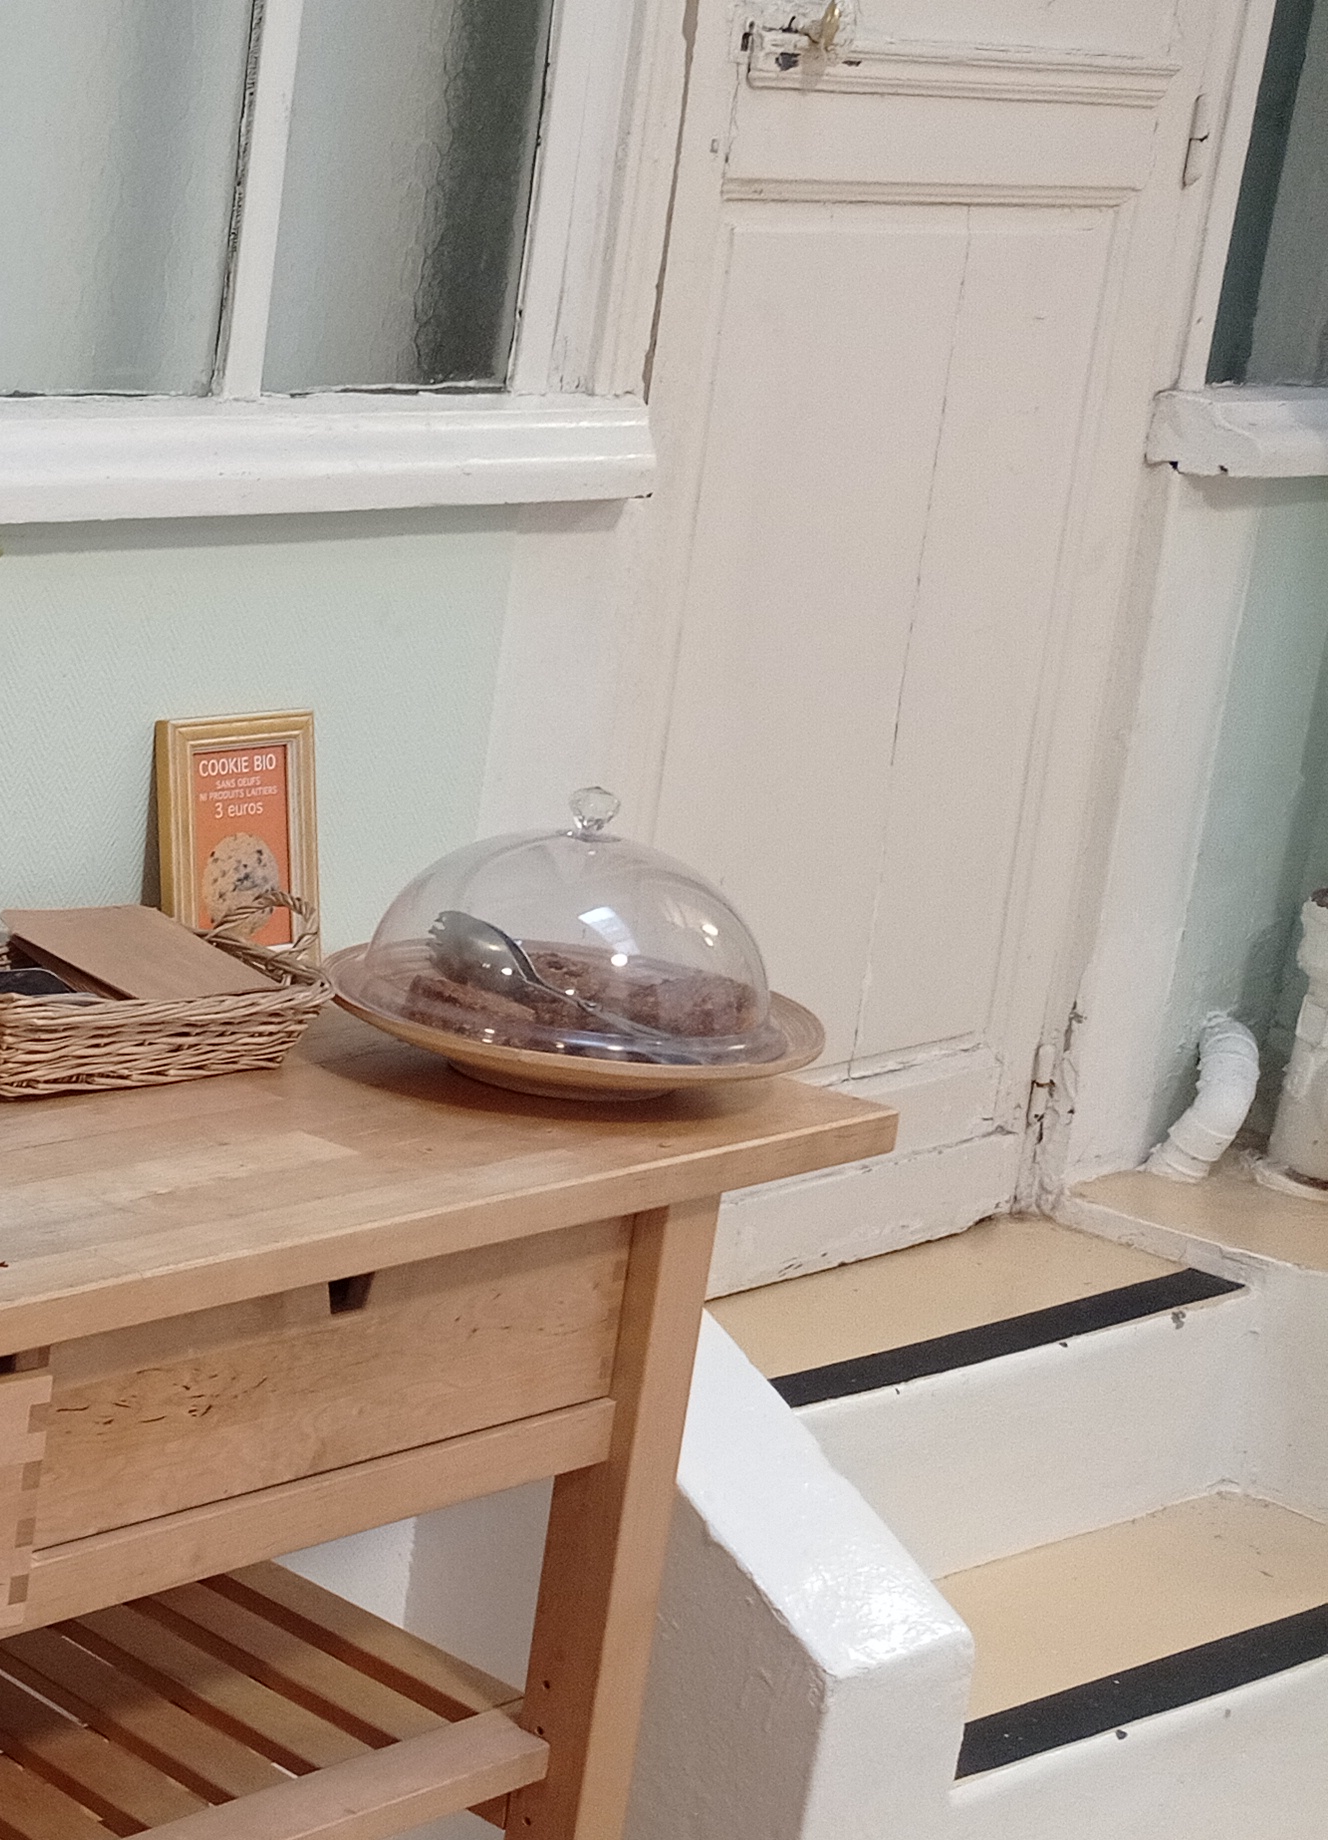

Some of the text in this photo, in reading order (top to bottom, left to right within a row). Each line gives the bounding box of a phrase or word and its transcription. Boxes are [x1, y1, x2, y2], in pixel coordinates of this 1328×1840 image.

[199, 753, 276, 777] COOKIE BIO
[209, 788, 244, 801] PRODUITS
[246, 785, 278, 798] LAITIERS
[216, 779, 236, 790] SANS
[215, 801, 264, 819] 3 euros
